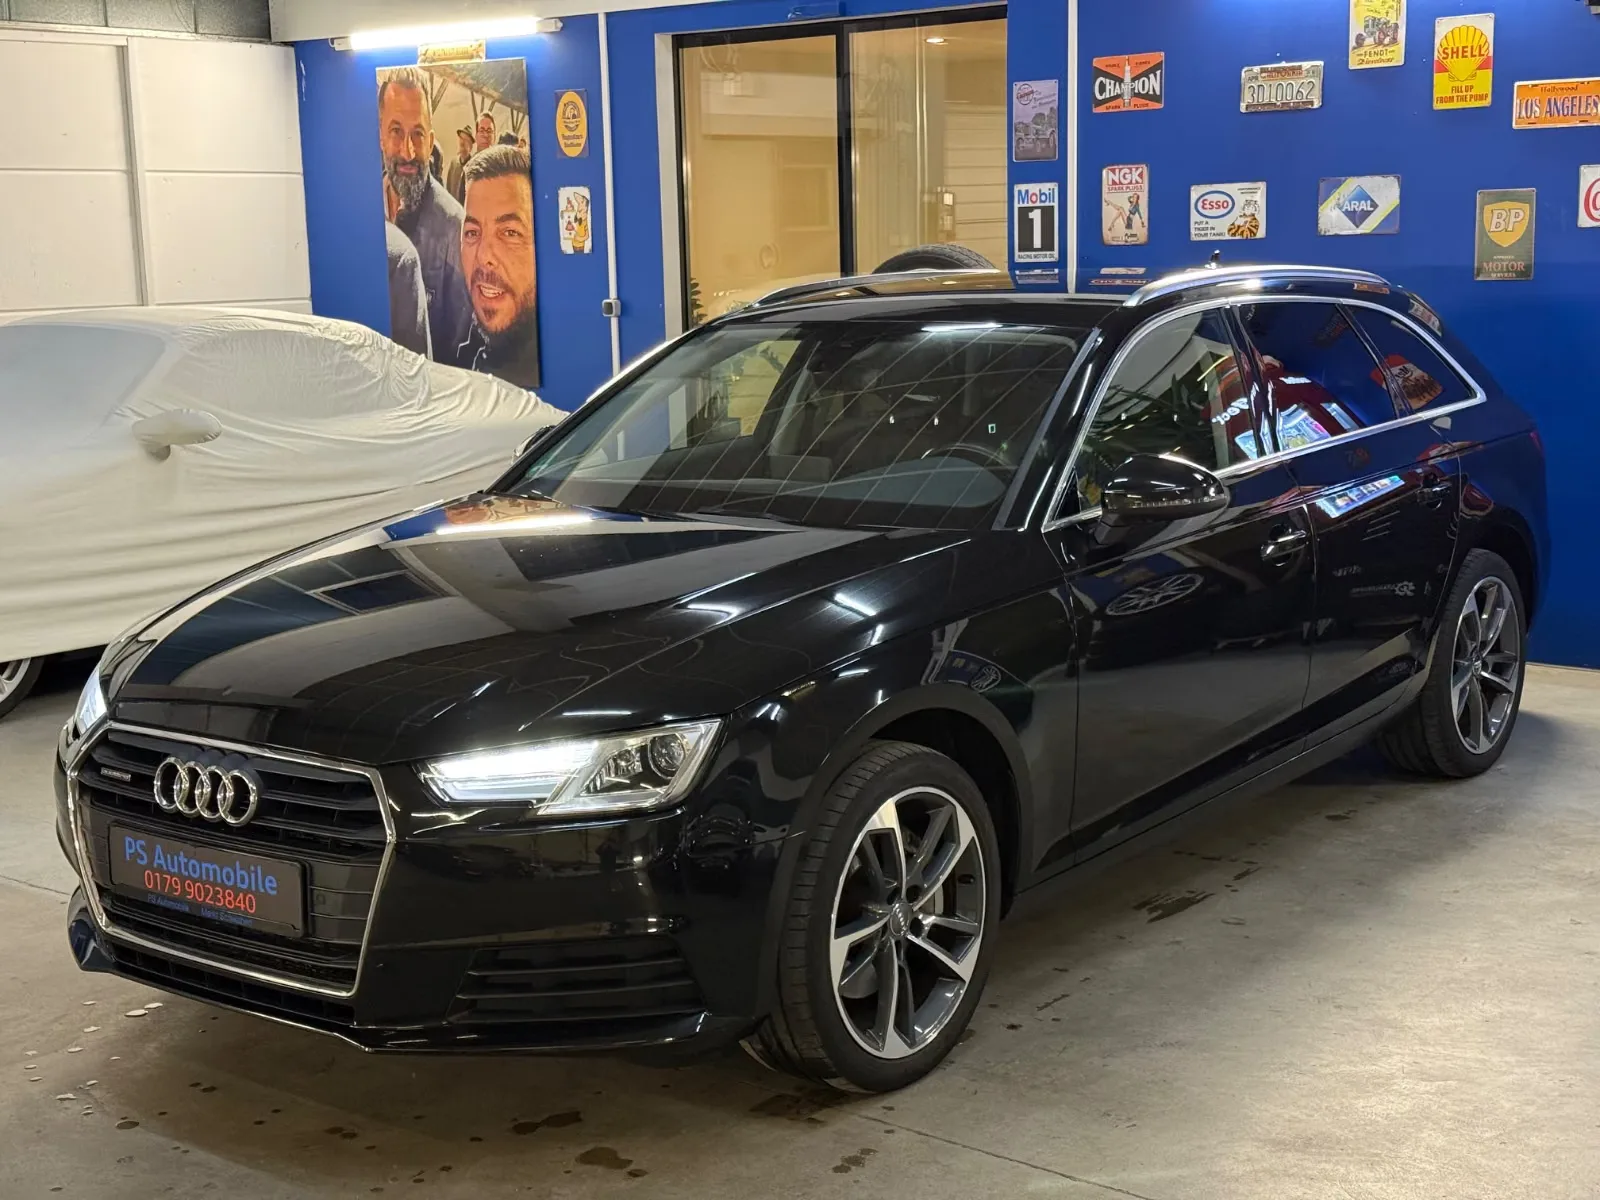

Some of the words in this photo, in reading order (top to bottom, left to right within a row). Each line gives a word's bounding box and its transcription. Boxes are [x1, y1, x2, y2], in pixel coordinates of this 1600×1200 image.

[1364, 49, 1388, 58] FENDT
[1442, 45, 1485, 60] SHELL
[1094, 69, 1162, 100] CHAMPION
[1451, 85, 1463, 94] FILL
[1464, 85, 1474, 93] UP
[1540, 85, 1579, 93] Hollywood
[1436, 96, 1455, 104] FROM
[1456, 94, 1468, 103] THE
[1469, 93, 1489, 102] PUMP
[1517, 97, 1541, 119] LOS
[1107, 167, 1143, 186] NGK
[1017, 188, 1055, 205] Mobil
[1342, 200, 1374, 212] ARAL
[1028, 208, 1042, 249] 1
[1489, 208, 1525, 233] BP
[1482, 261, 1525, 272] MOTOR
[125, 836, 148, 866] PS
[154, 844, 278, 896] Automobile
[144, 869, 181, 897] 0179
[185, 879, 256, 915] 9023840
